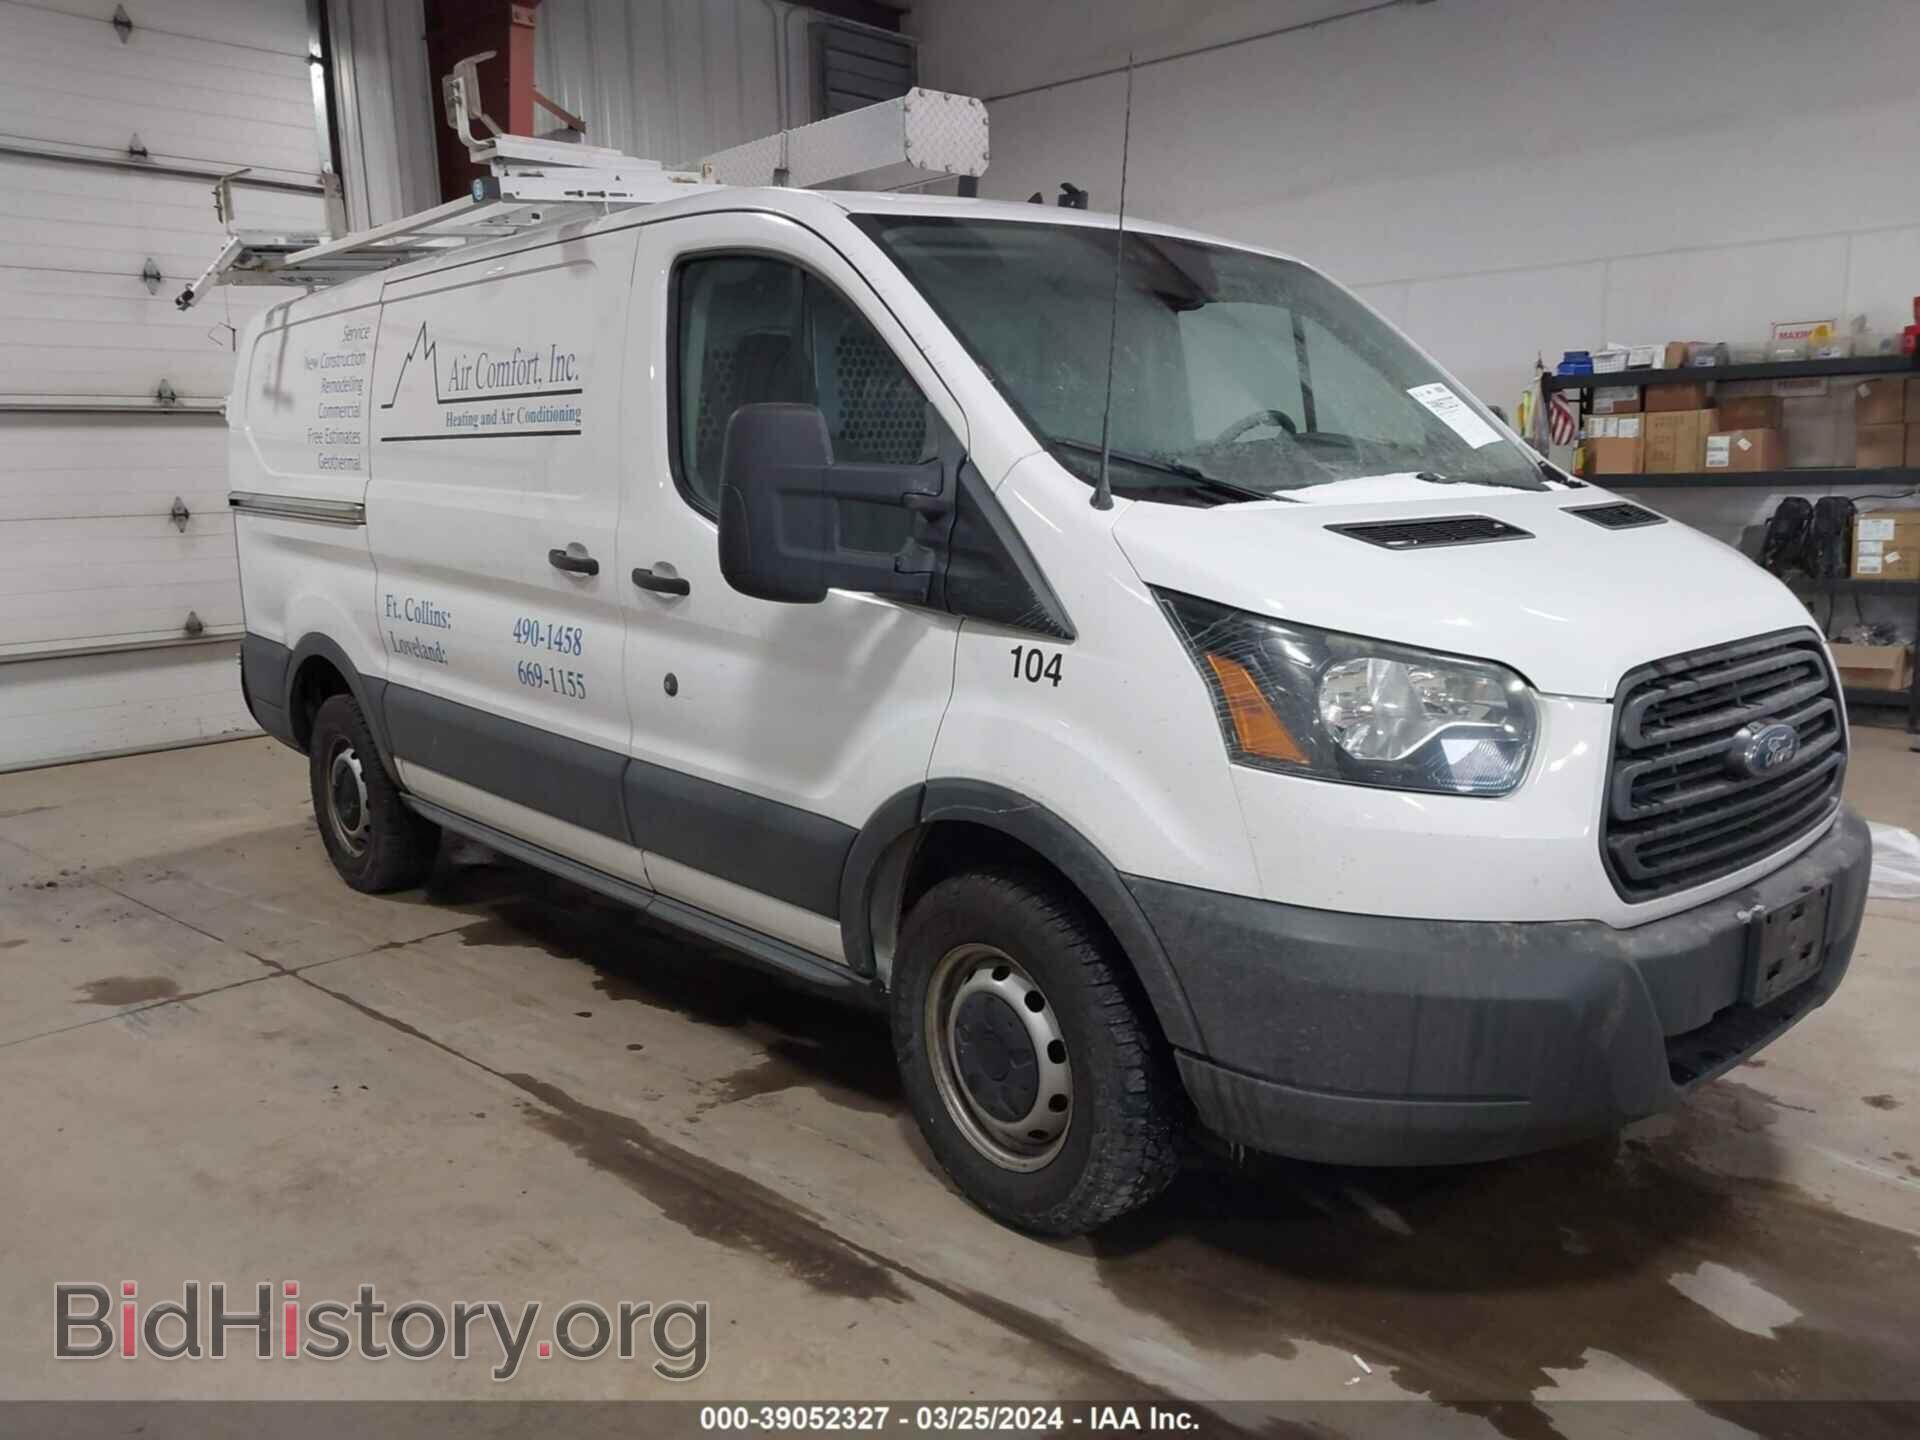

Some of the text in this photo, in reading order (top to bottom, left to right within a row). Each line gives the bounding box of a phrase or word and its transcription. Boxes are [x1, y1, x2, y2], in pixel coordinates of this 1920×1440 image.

[448, 344, 579, 392] Air Comfort, Inc.
[445, 404, 582, 428] Heating and Air Conditioning
[307, 427, 323, 445] Free
[385, 594, 451, 630] Ft. Collins:
[389, 631, 448, 665] Loveland:
[513, 617, 583, 656] 490-1458
[517, 660, 586, 700] 669-1155
[1010, 645, 1063, 687] 104
